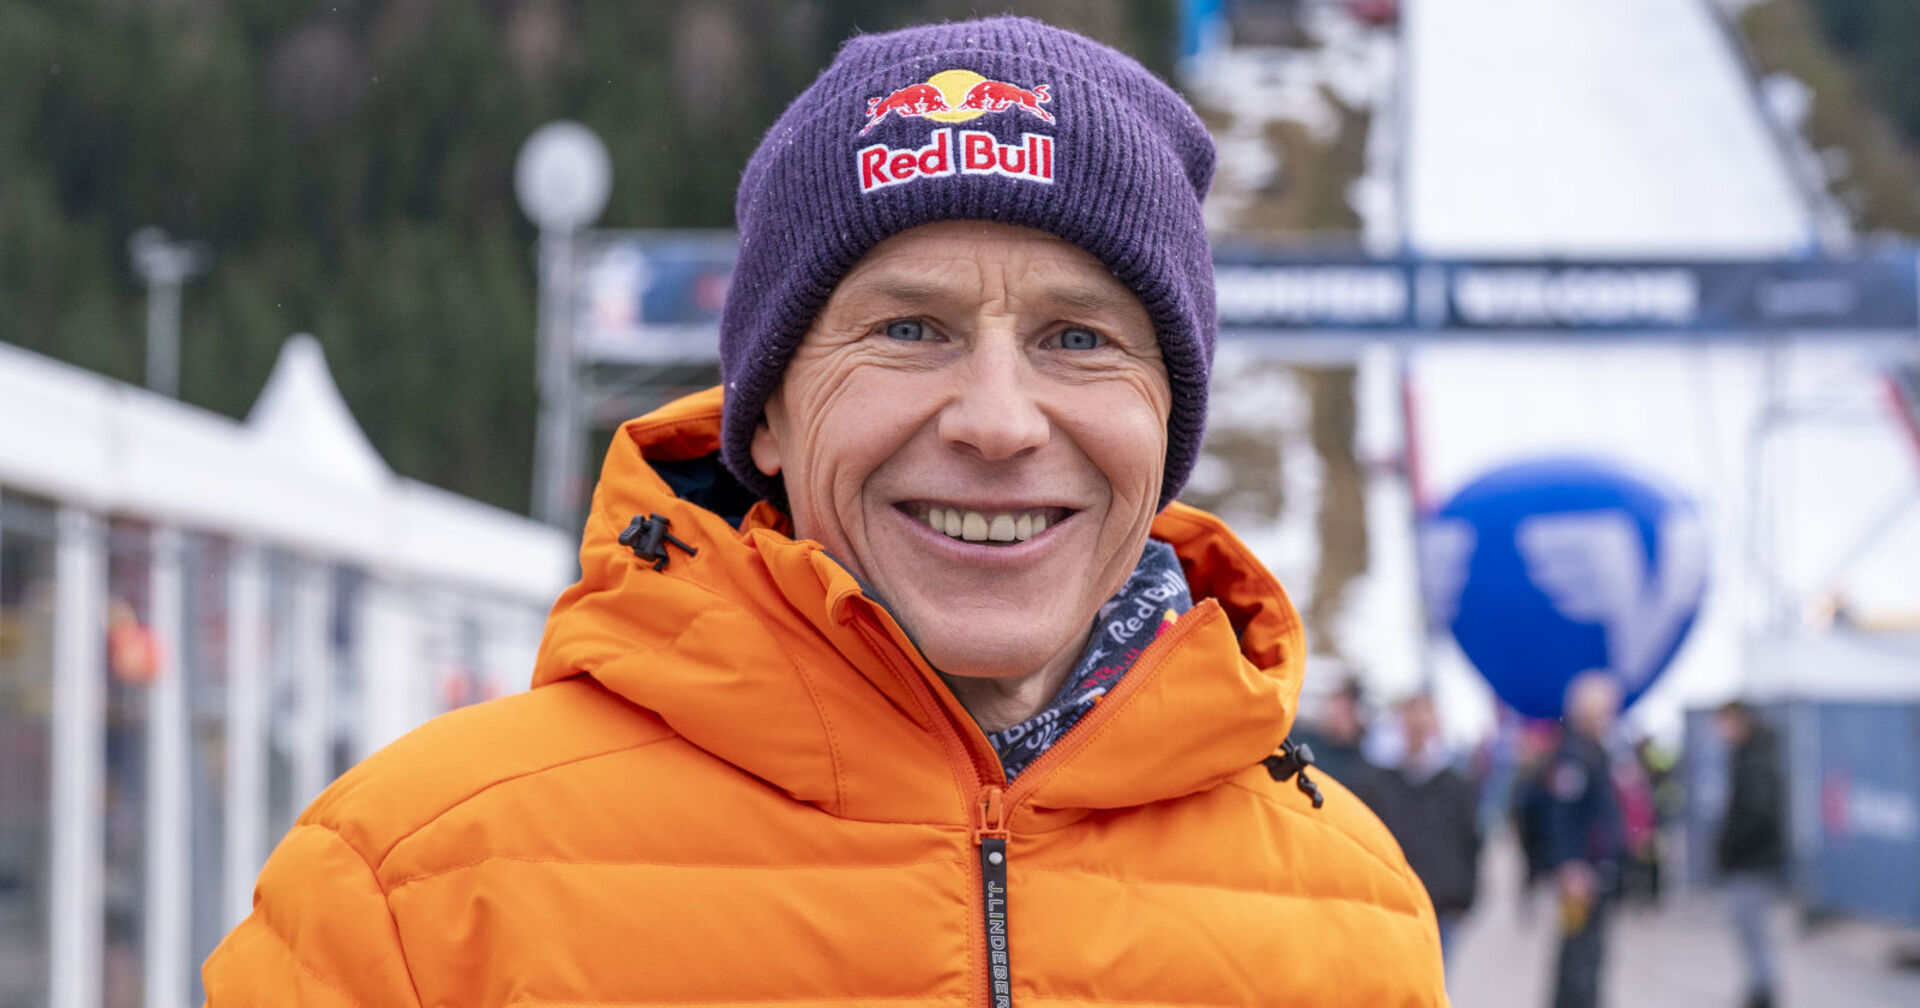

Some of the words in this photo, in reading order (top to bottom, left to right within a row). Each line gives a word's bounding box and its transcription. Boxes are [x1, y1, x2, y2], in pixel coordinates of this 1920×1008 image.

[860, 130, 952, 191] Red
[962, 132, 1053, 181] Bull
[1108, 598, 1157, 644] Red
[1143, 569, 1187, 602] Bull
